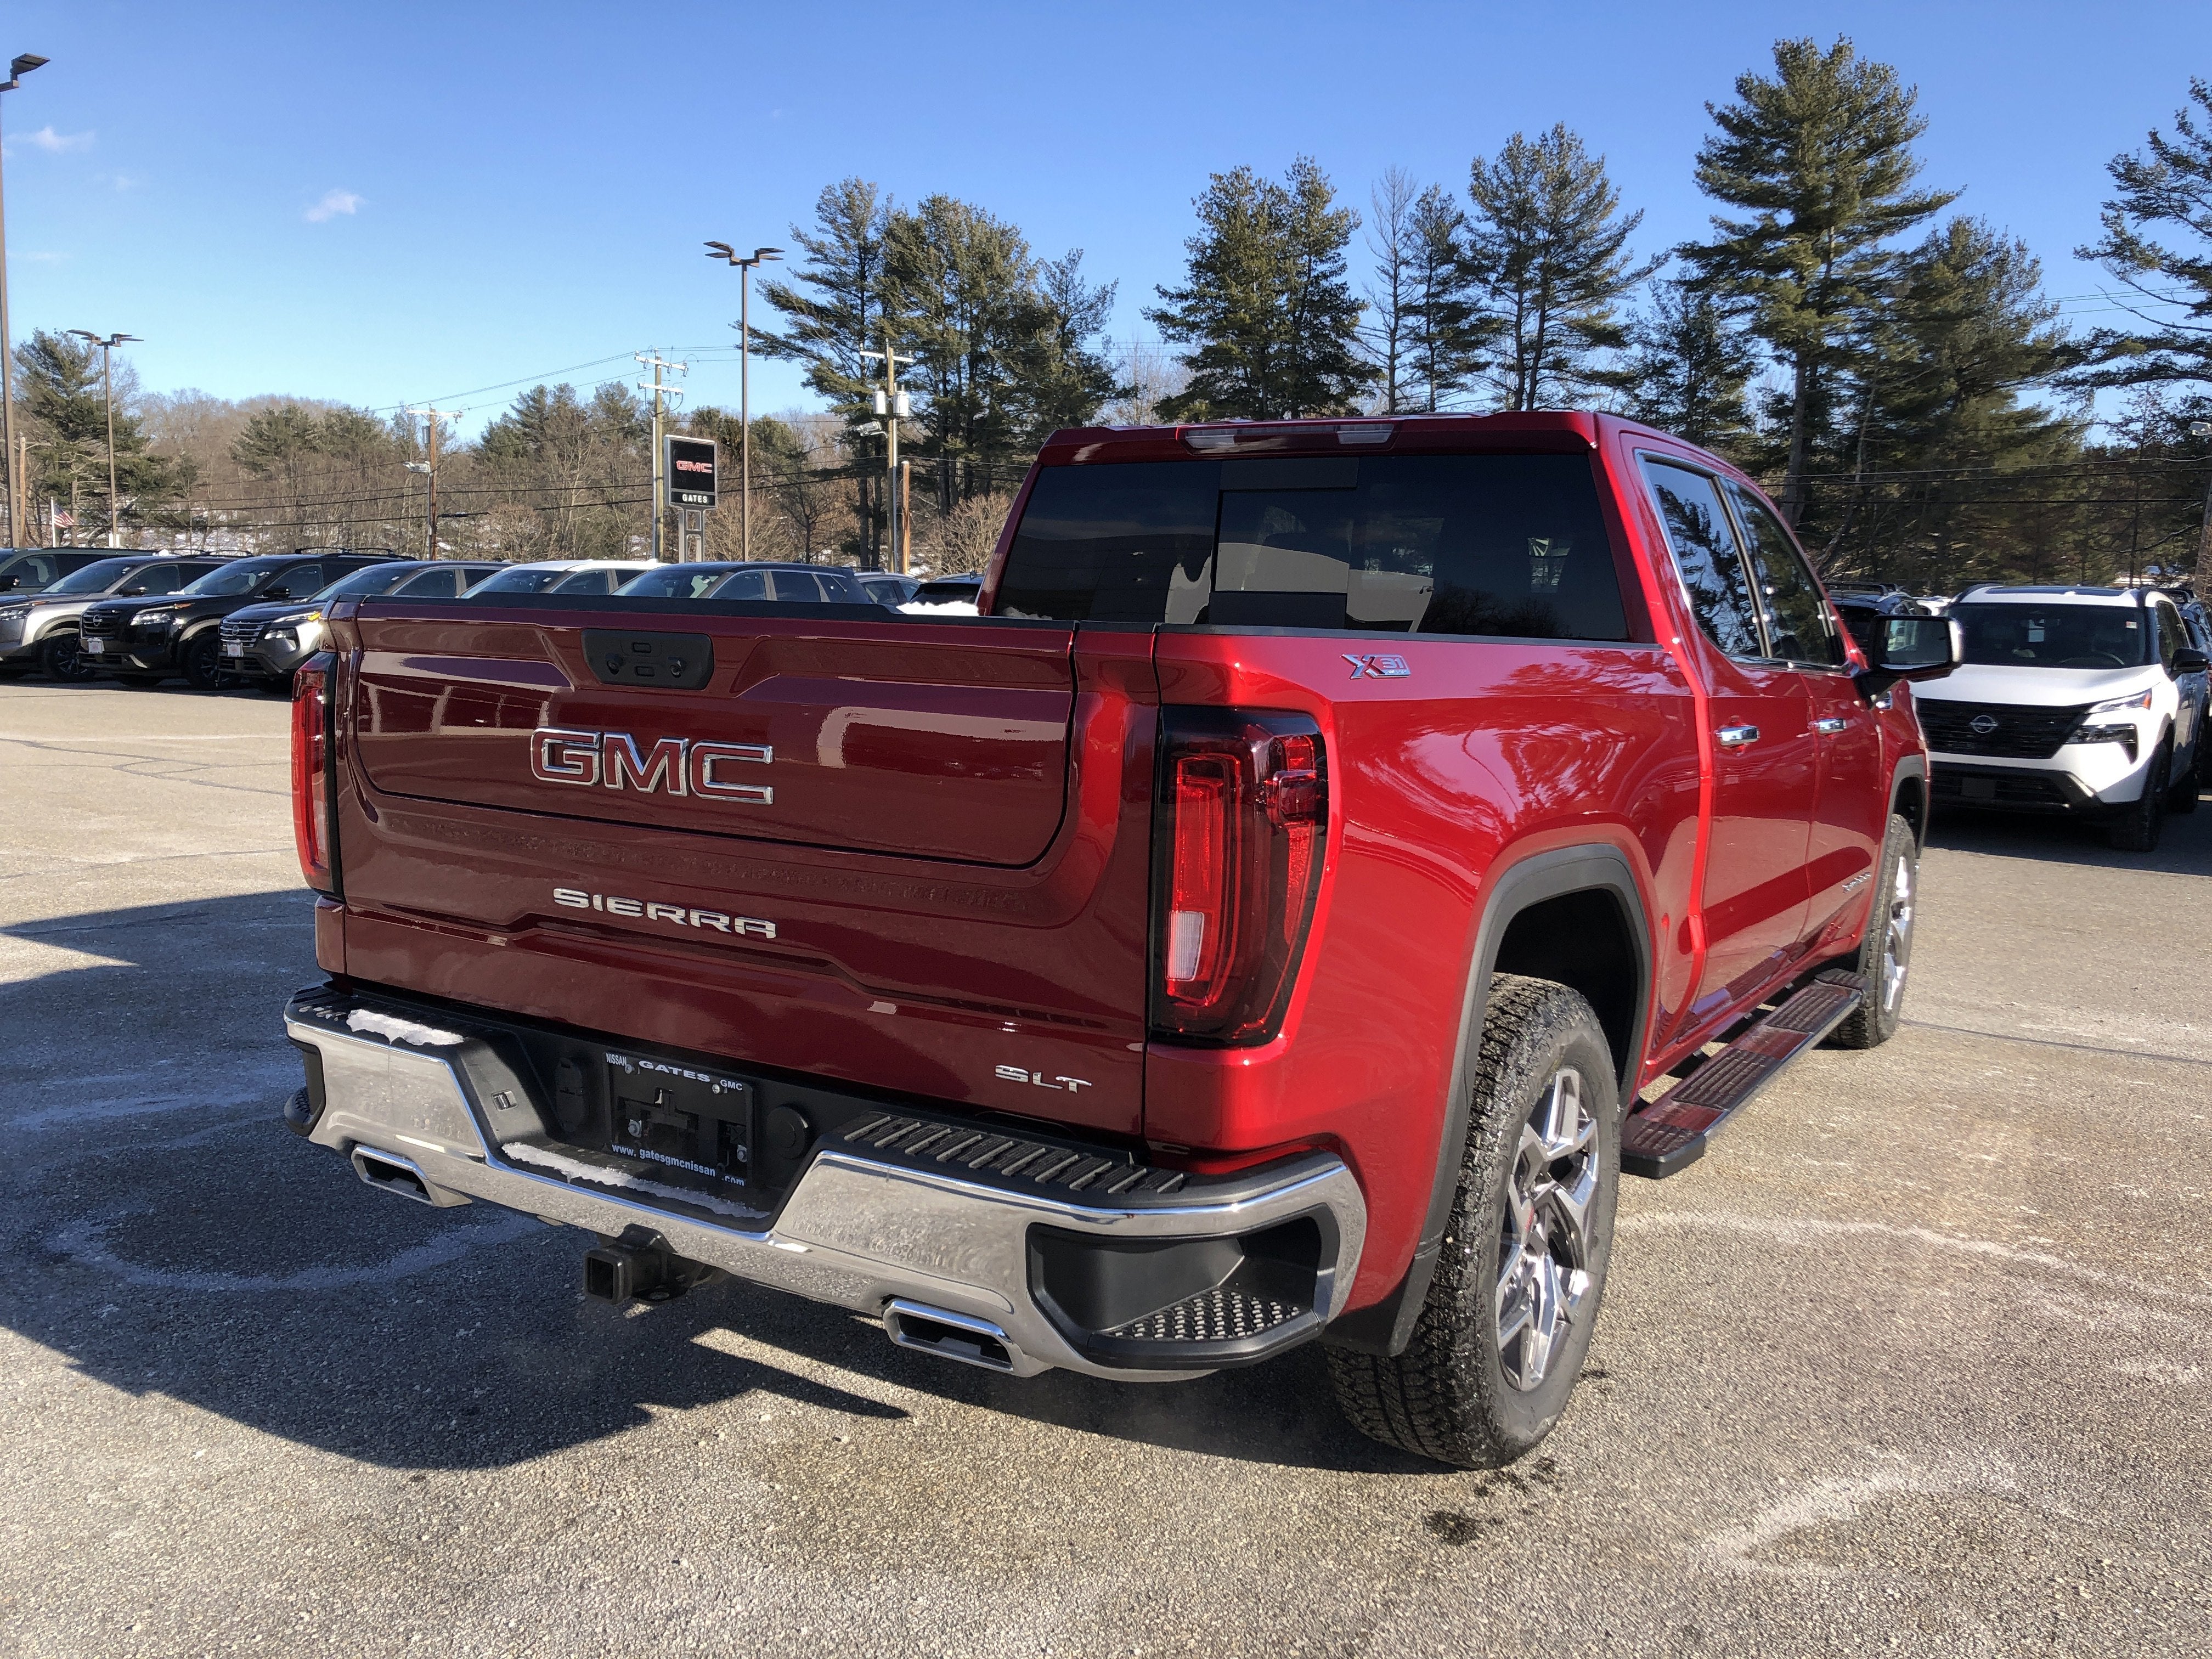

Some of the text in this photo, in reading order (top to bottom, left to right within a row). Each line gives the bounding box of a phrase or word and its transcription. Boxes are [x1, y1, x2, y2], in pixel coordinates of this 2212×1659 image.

[676, 460, 712, 473] GMC
[682, 494, 708, 503] GATES
[1340, 653, 1411, 679] X31
[530, 726, 773, 805] GMC
[553, 888, 776, 939] SIERRA
[606, 1053, 627, 1066] NISSAN
[639, 1060, 710, 1082] GATES
[995, 1065, 1092, 1093] SLT
[720, 1079, 743, 1091] GMC
